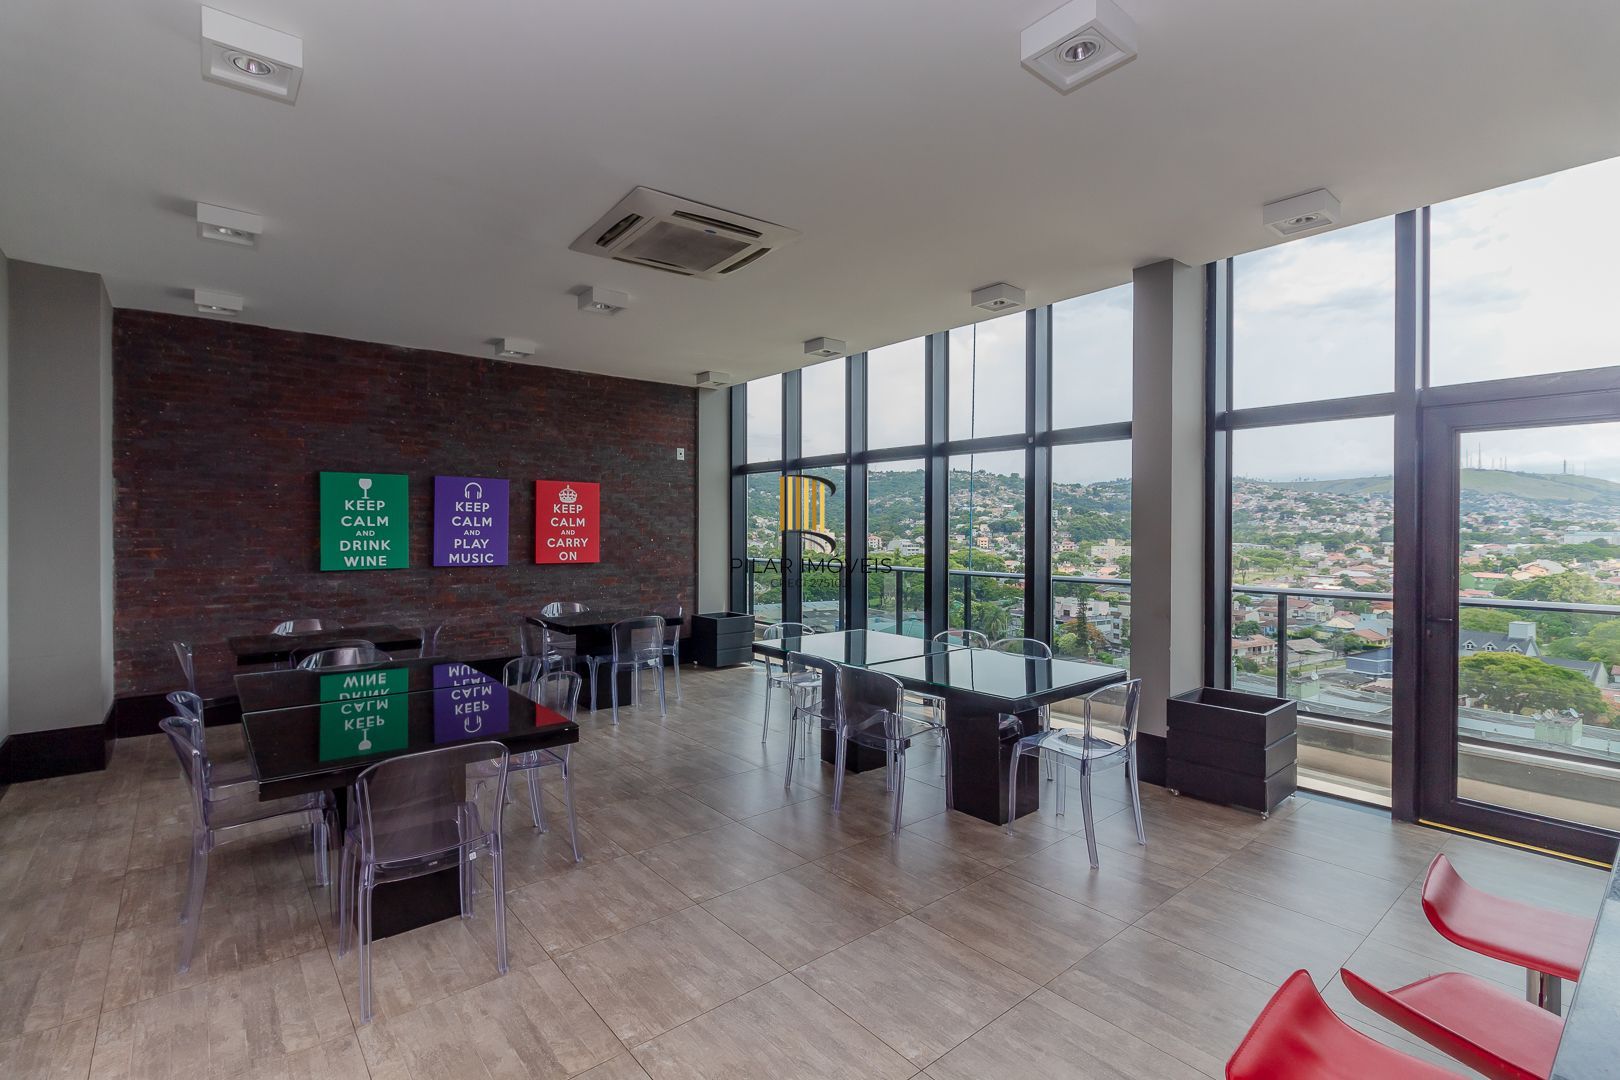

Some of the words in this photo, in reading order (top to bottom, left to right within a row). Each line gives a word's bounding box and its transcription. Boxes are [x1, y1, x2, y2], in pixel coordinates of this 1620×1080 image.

[344, 500, 386, 511] KEEP
[455, 501, 490, 512] KEEP
[553, 503, 583, 514] KEEP
[340, 515, 389, 527] CALM
[451, 516, 493, 527] CALM
[550, 517, 586, 527] CALM
[339, 539, 391, 552] DRINK
[454, 538, 490, 549] PLAY
[546, 537, 589, 548] CARRY
[343, 555, 387, 567] WINE
[448, 552, 494, 564] MUSIC
[558, 551, 577, 561] ON
